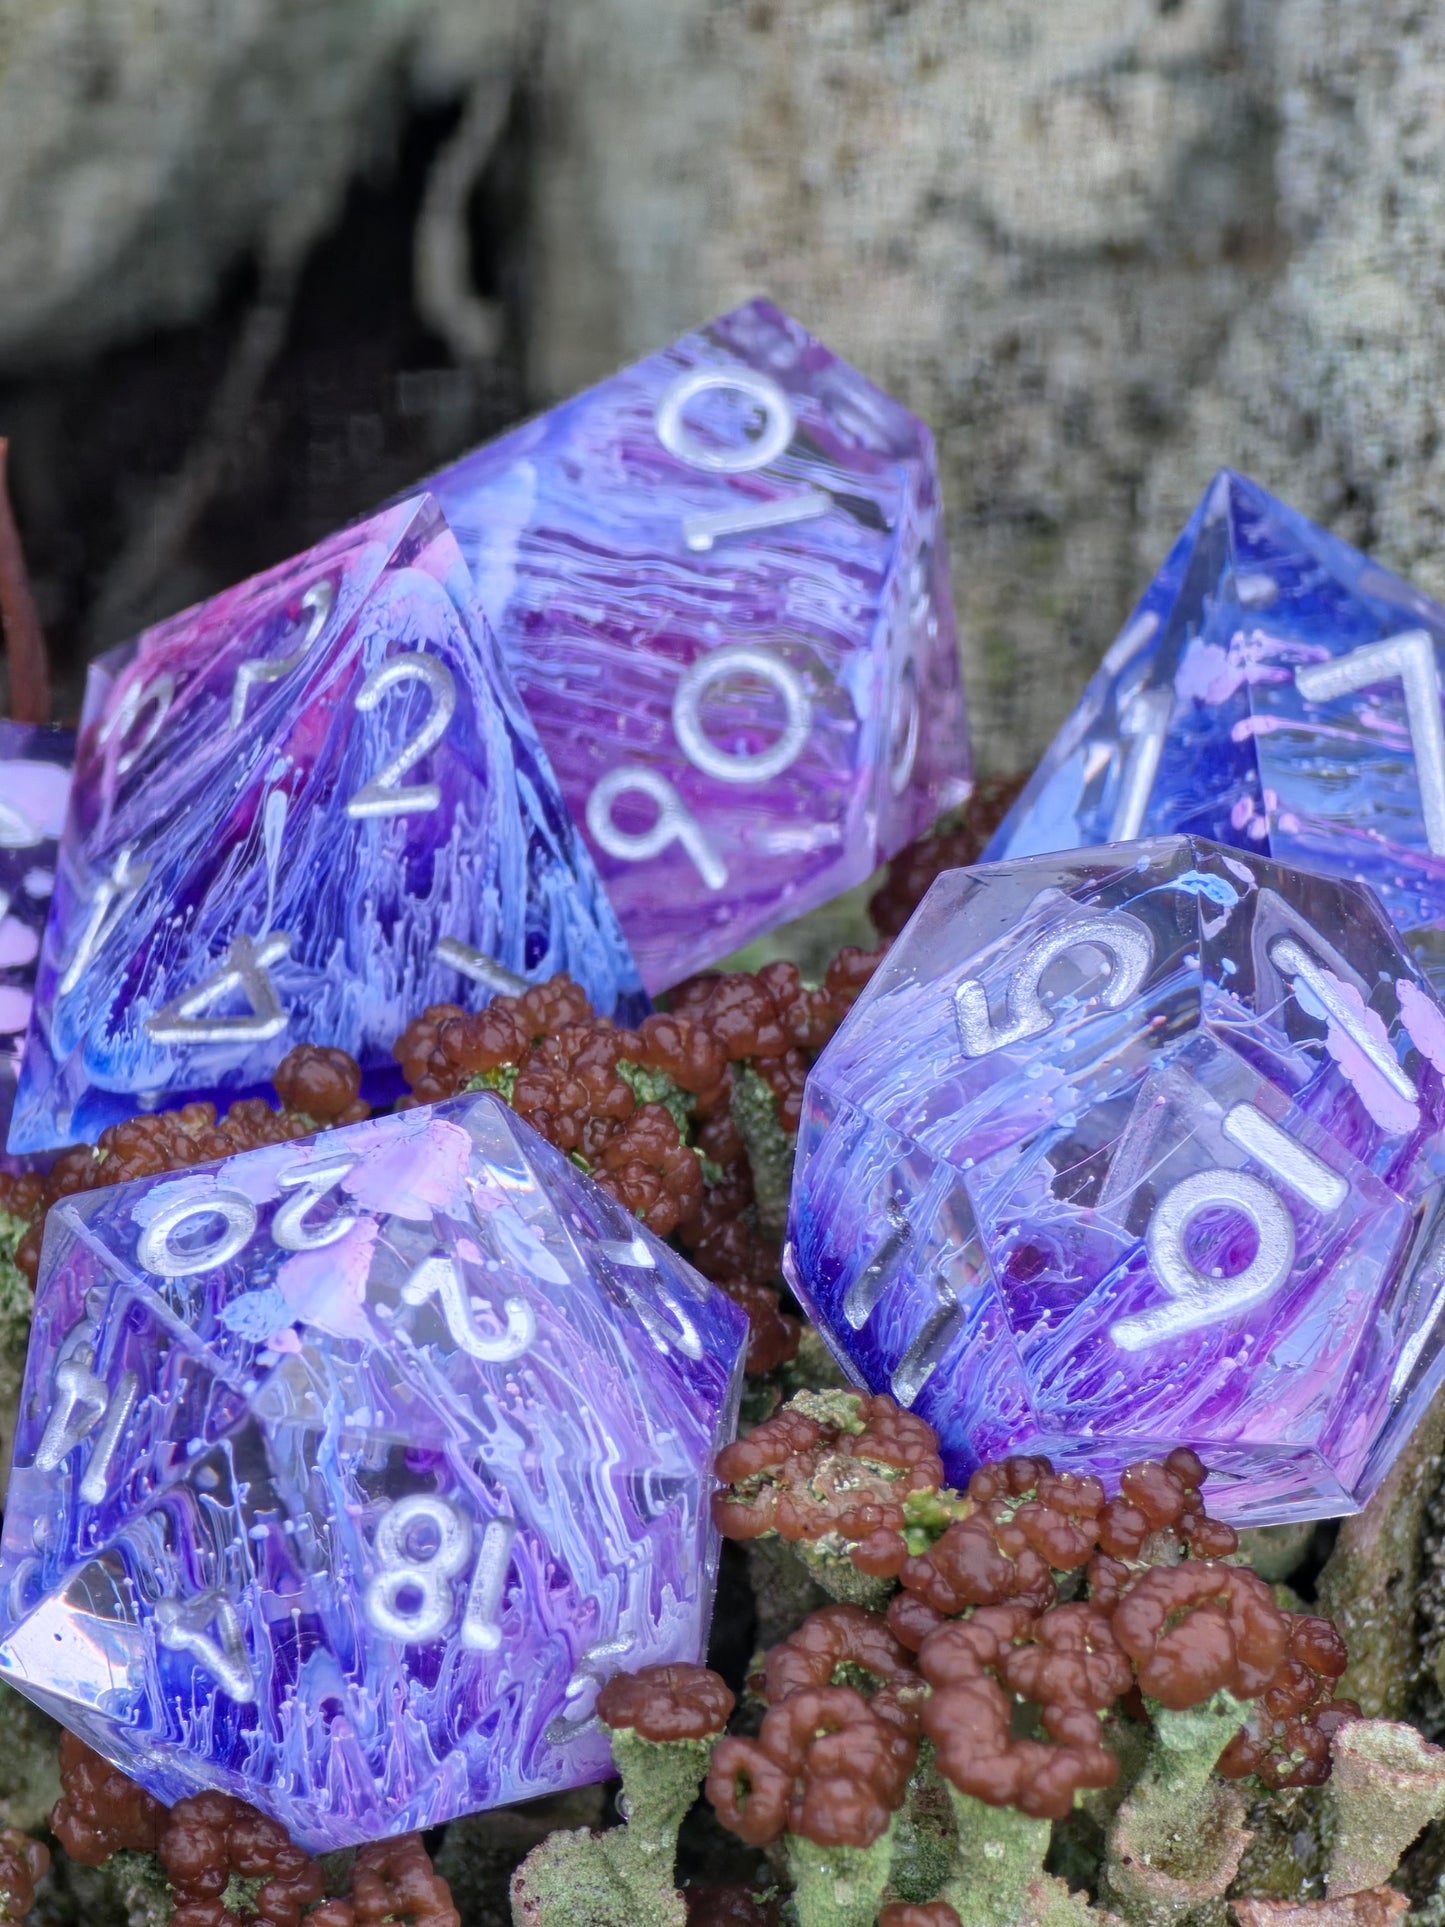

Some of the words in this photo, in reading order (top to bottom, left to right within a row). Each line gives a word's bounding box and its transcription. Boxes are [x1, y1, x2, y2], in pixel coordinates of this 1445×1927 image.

[348, 651, 457, 819] 2
[1296, 629, 1445, 857] 7
[145, 932, 290, 1044] 4
[955, 917, 1154, 1058] 5
[137, 1154, 358, 1277] 20
[403, 1256, 537, 1363] 2
[369, 1494, 514, 1652] 18
